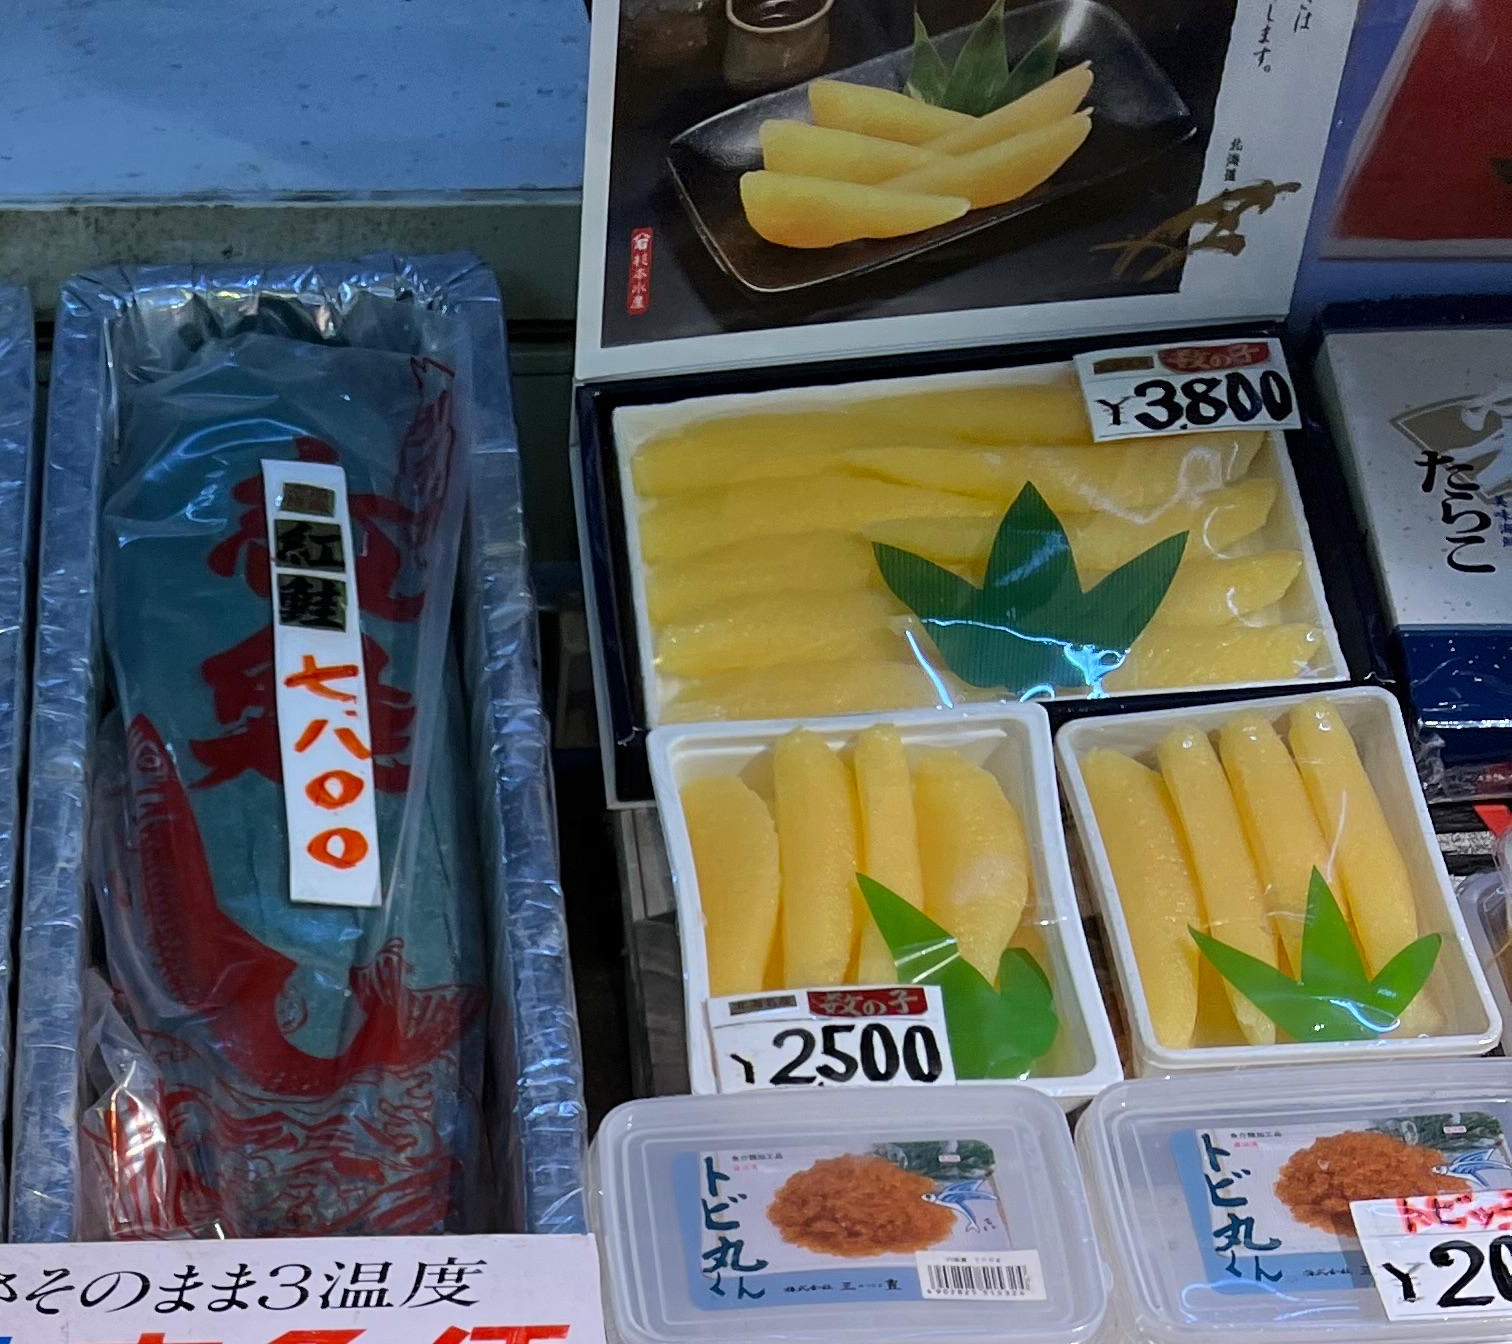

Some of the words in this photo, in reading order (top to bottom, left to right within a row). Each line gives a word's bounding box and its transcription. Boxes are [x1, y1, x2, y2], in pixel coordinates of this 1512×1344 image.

[1173, 345, 1260, 371] 数の子
[1415, 450, 1496, 573] たらこ
[276, 522, 346, 630] 紅鮭
[819, 988, 919, 1017] 数の子
